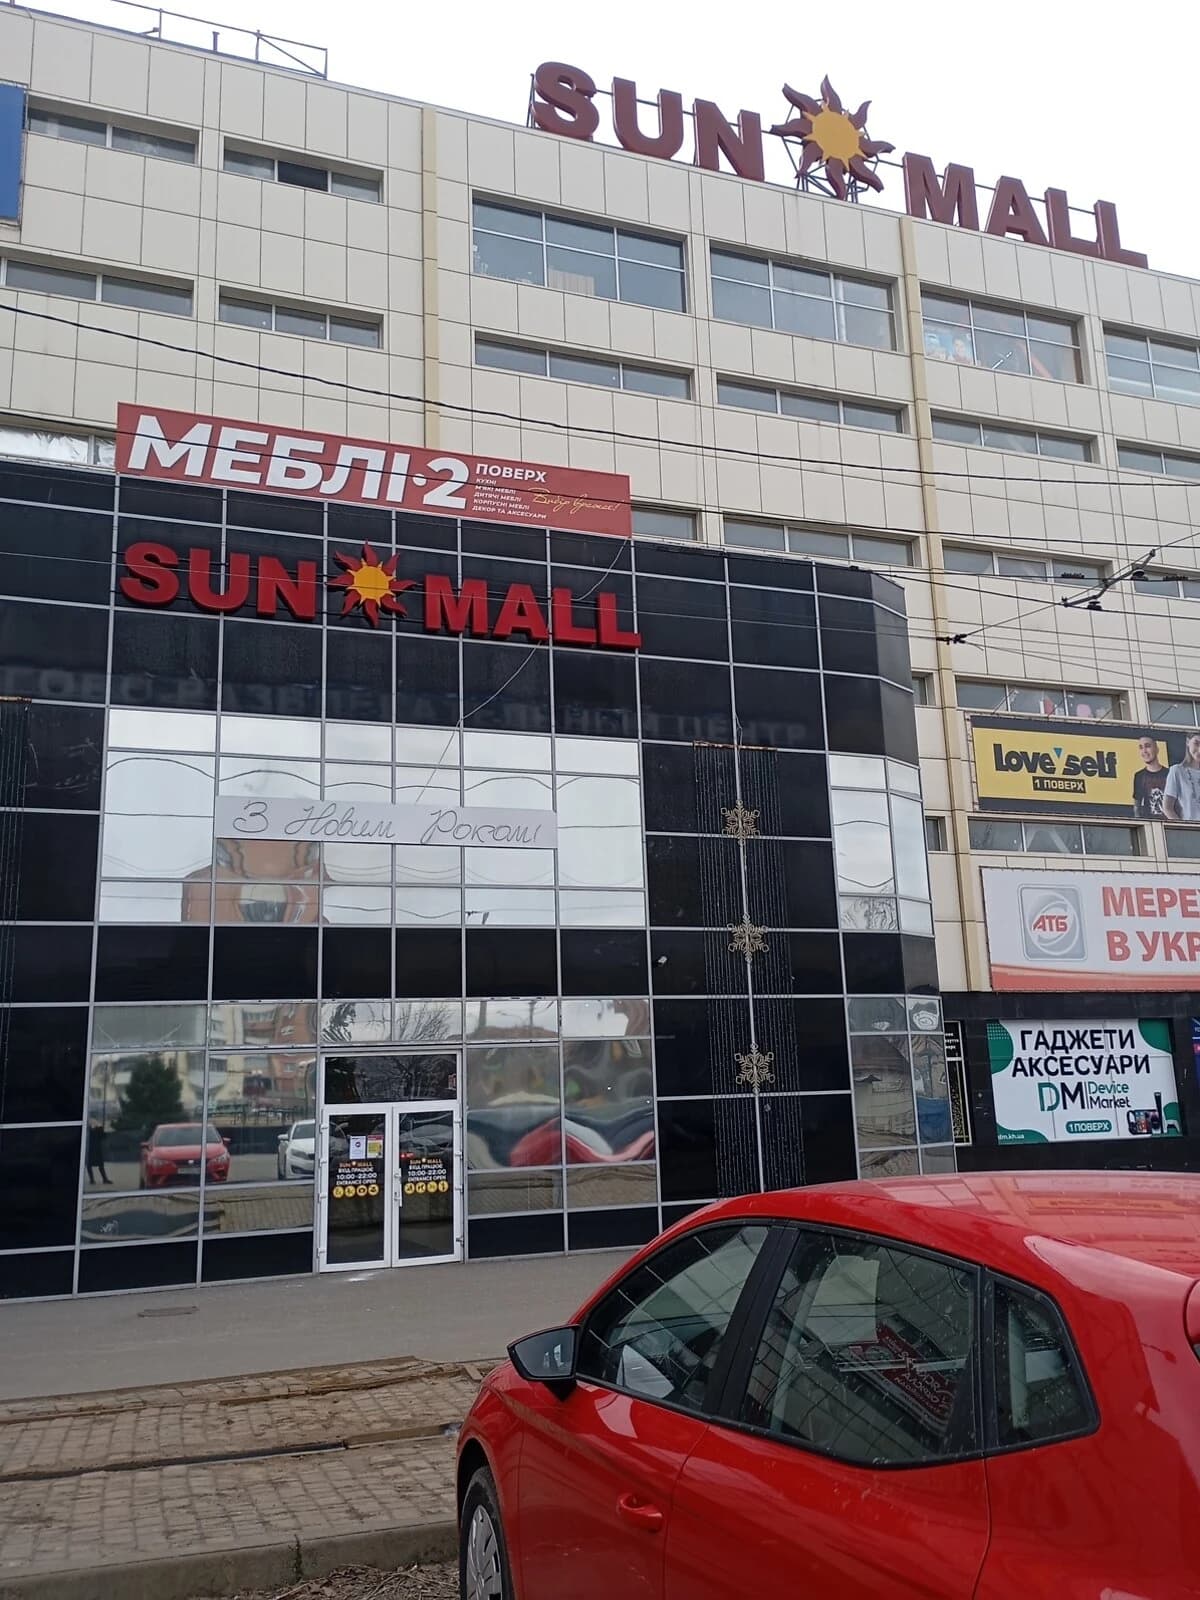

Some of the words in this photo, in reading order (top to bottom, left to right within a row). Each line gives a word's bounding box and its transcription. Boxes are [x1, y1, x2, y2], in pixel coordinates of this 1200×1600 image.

[532, 61, 764, 182] SUN
[903, 152, 1148, 270] MALL
[127, 414, 410, 503] МЕБЛІ
[422, 457, 470, 509] 2
[475, 463, 548, 483] ПОВЕРХ
[475, 478, 497, 486] КУХНІ
[473, 492, 500, 500] ДИТЯЧІ
[500, 494, 522, 502] МЕБЛІ
[494, 487, 517, 495] МЕБЛІ
[472, 505, 497, 513] ДЕКОР
[506, 509, 547, 520] АКСЕСУАРИ
[473, 498, 508, 507] КОРПУСНІ
[508, 502, 530, 510] МЕБЛІ
[120, 542, 317, 621] SUN
[424, 574, 642, 649] MALL
[1034, 779, 1041, 789] 1
[1043, 780, 1085, 791] ПОВЕРХ
[284, 803, 396, 839] Новим
[1102, 886, 1200, 918] МЕРЕ
[1032, 915, 1069, 933] АТБ
[1106, 930, 1131, 962] В
[1020, 1030, 1136, 1055] ГАДЖЕТИ
[1012, 1054, 1151, 1078] АКСЕСУАРИ
[1037, 1081, 1086, 1112] DM
[1088, 1081, 1130, 1095] Device
[1089, 1095, 1132, 1110] Market
